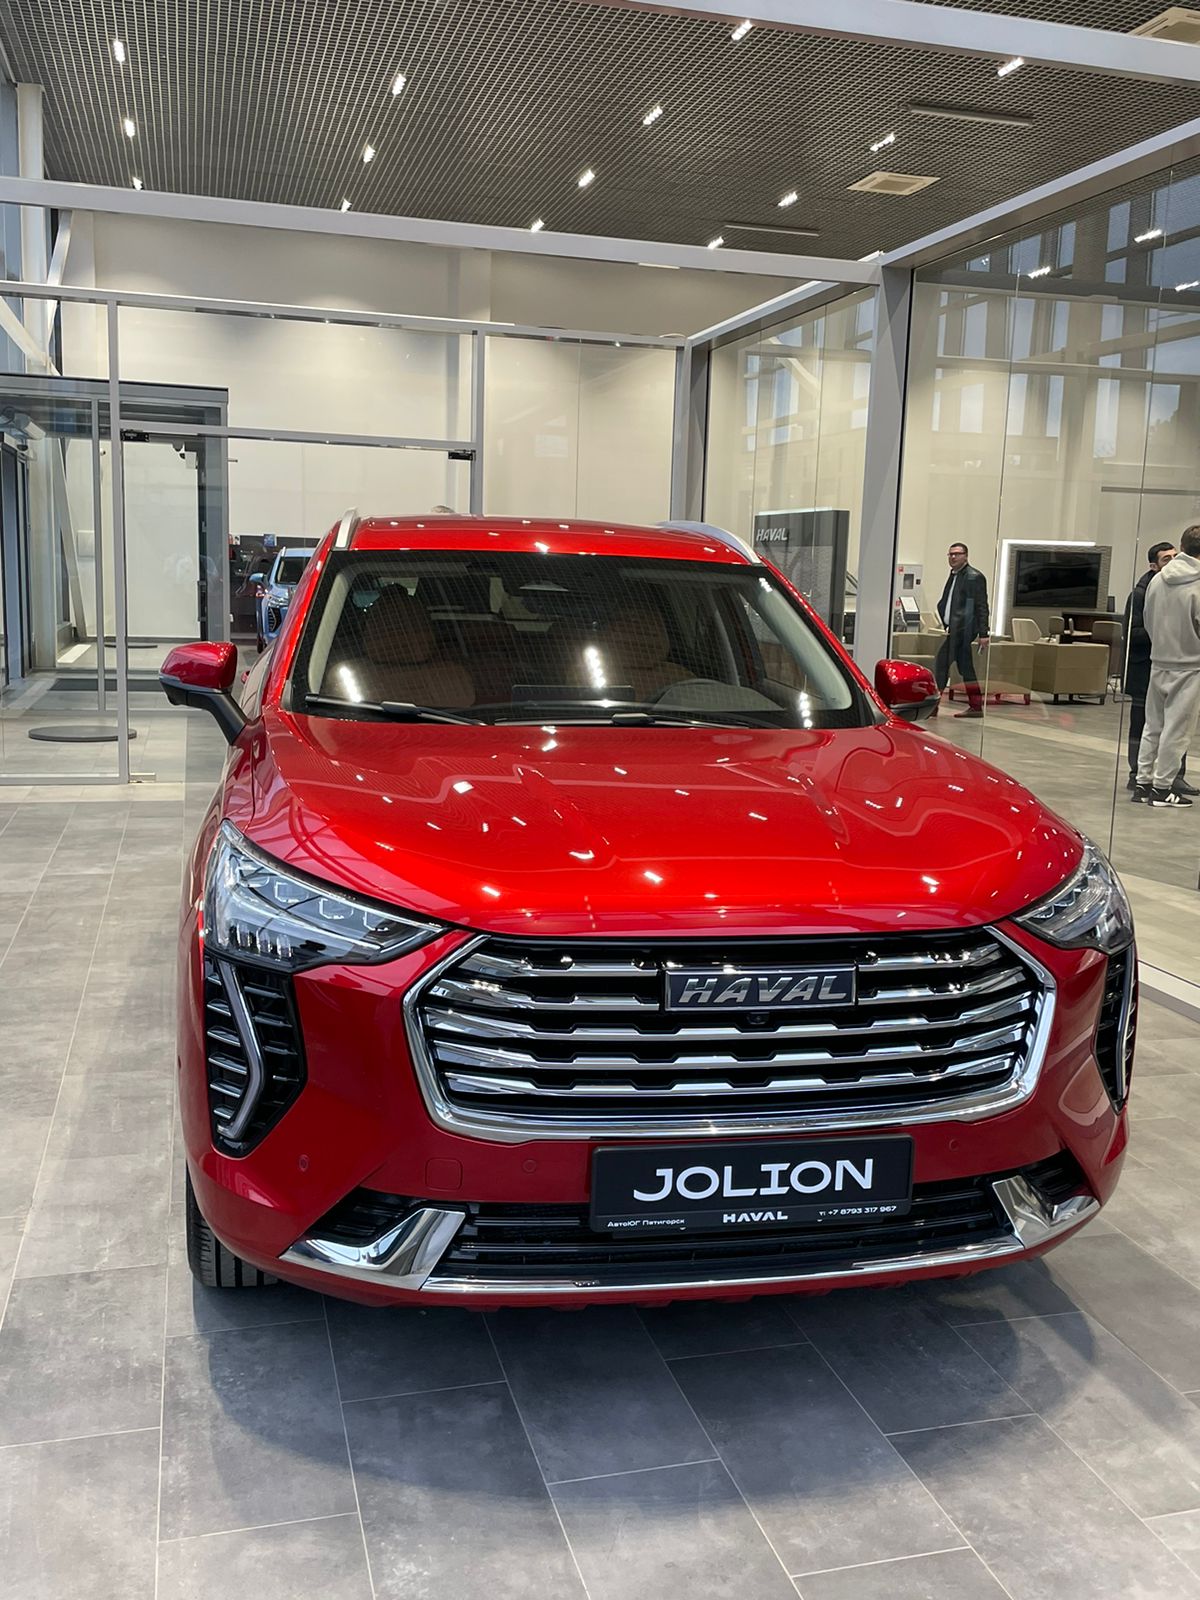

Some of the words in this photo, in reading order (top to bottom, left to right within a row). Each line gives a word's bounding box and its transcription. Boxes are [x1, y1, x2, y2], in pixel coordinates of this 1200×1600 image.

[756, 527, 788, 542] HAVAL
[678, 975, 847, 1003] HAVAL
[633, 1158, 874, 1202] JOLION
[723, 1211, 789, 1224] HAVAL
[828, 1208, 839, 1216] +7
[840, 1207, 863, 1215] 8793
[864, 1206, 878, 1214] 317
[879, 1205, 897, 1213] 967
